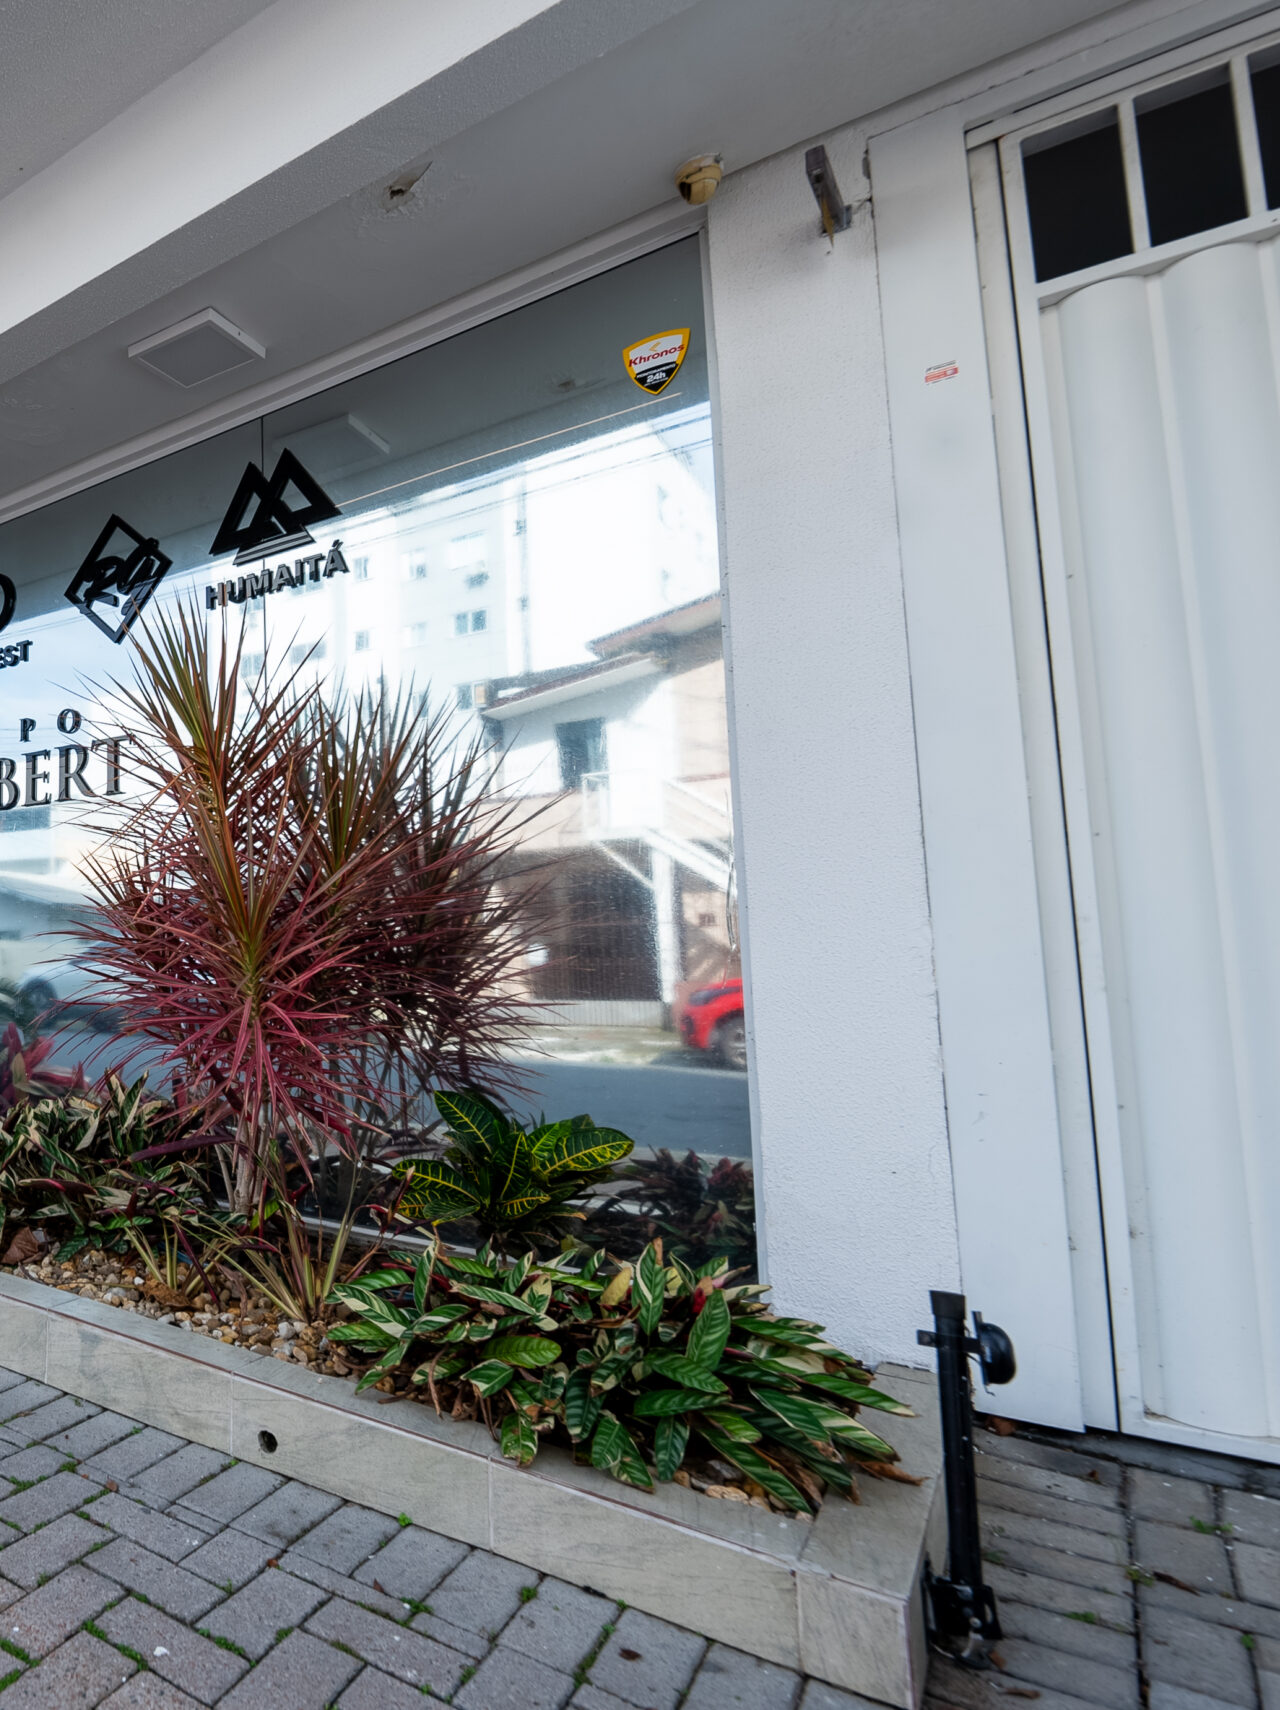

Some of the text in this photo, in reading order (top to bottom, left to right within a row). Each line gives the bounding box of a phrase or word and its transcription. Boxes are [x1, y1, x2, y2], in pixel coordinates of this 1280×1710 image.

[628, 344, 686, 368] Khronos
[646, 371, 667, 384] 24h
[205, 539, 350, 611] HUMAITÁ
